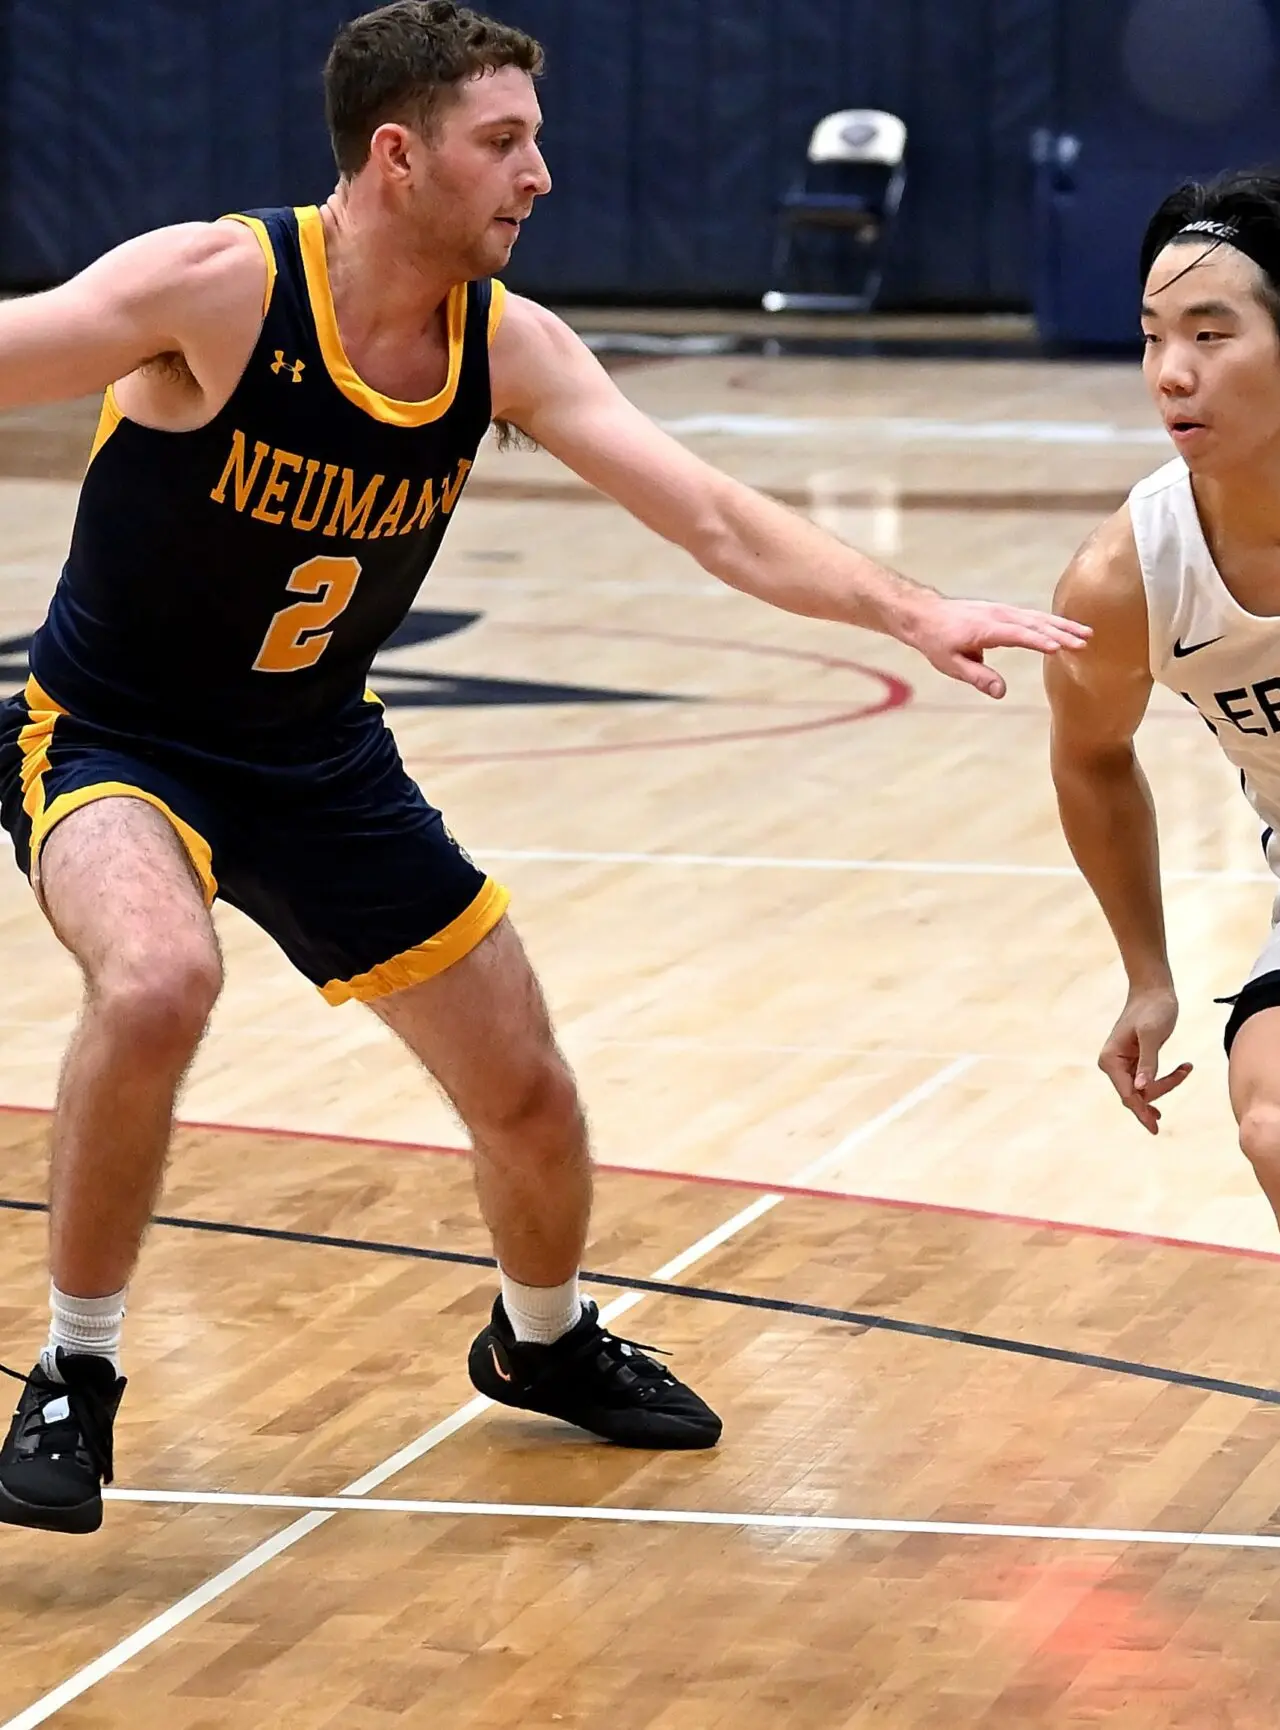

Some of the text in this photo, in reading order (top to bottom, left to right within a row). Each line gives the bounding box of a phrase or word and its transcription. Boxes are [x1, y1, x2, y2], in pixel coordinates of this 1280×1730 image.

[1178, 220, 1240, 239] NIKE
[210, 429, 472, 540] NEUMANN
[251, 555, 362, 673] 2
